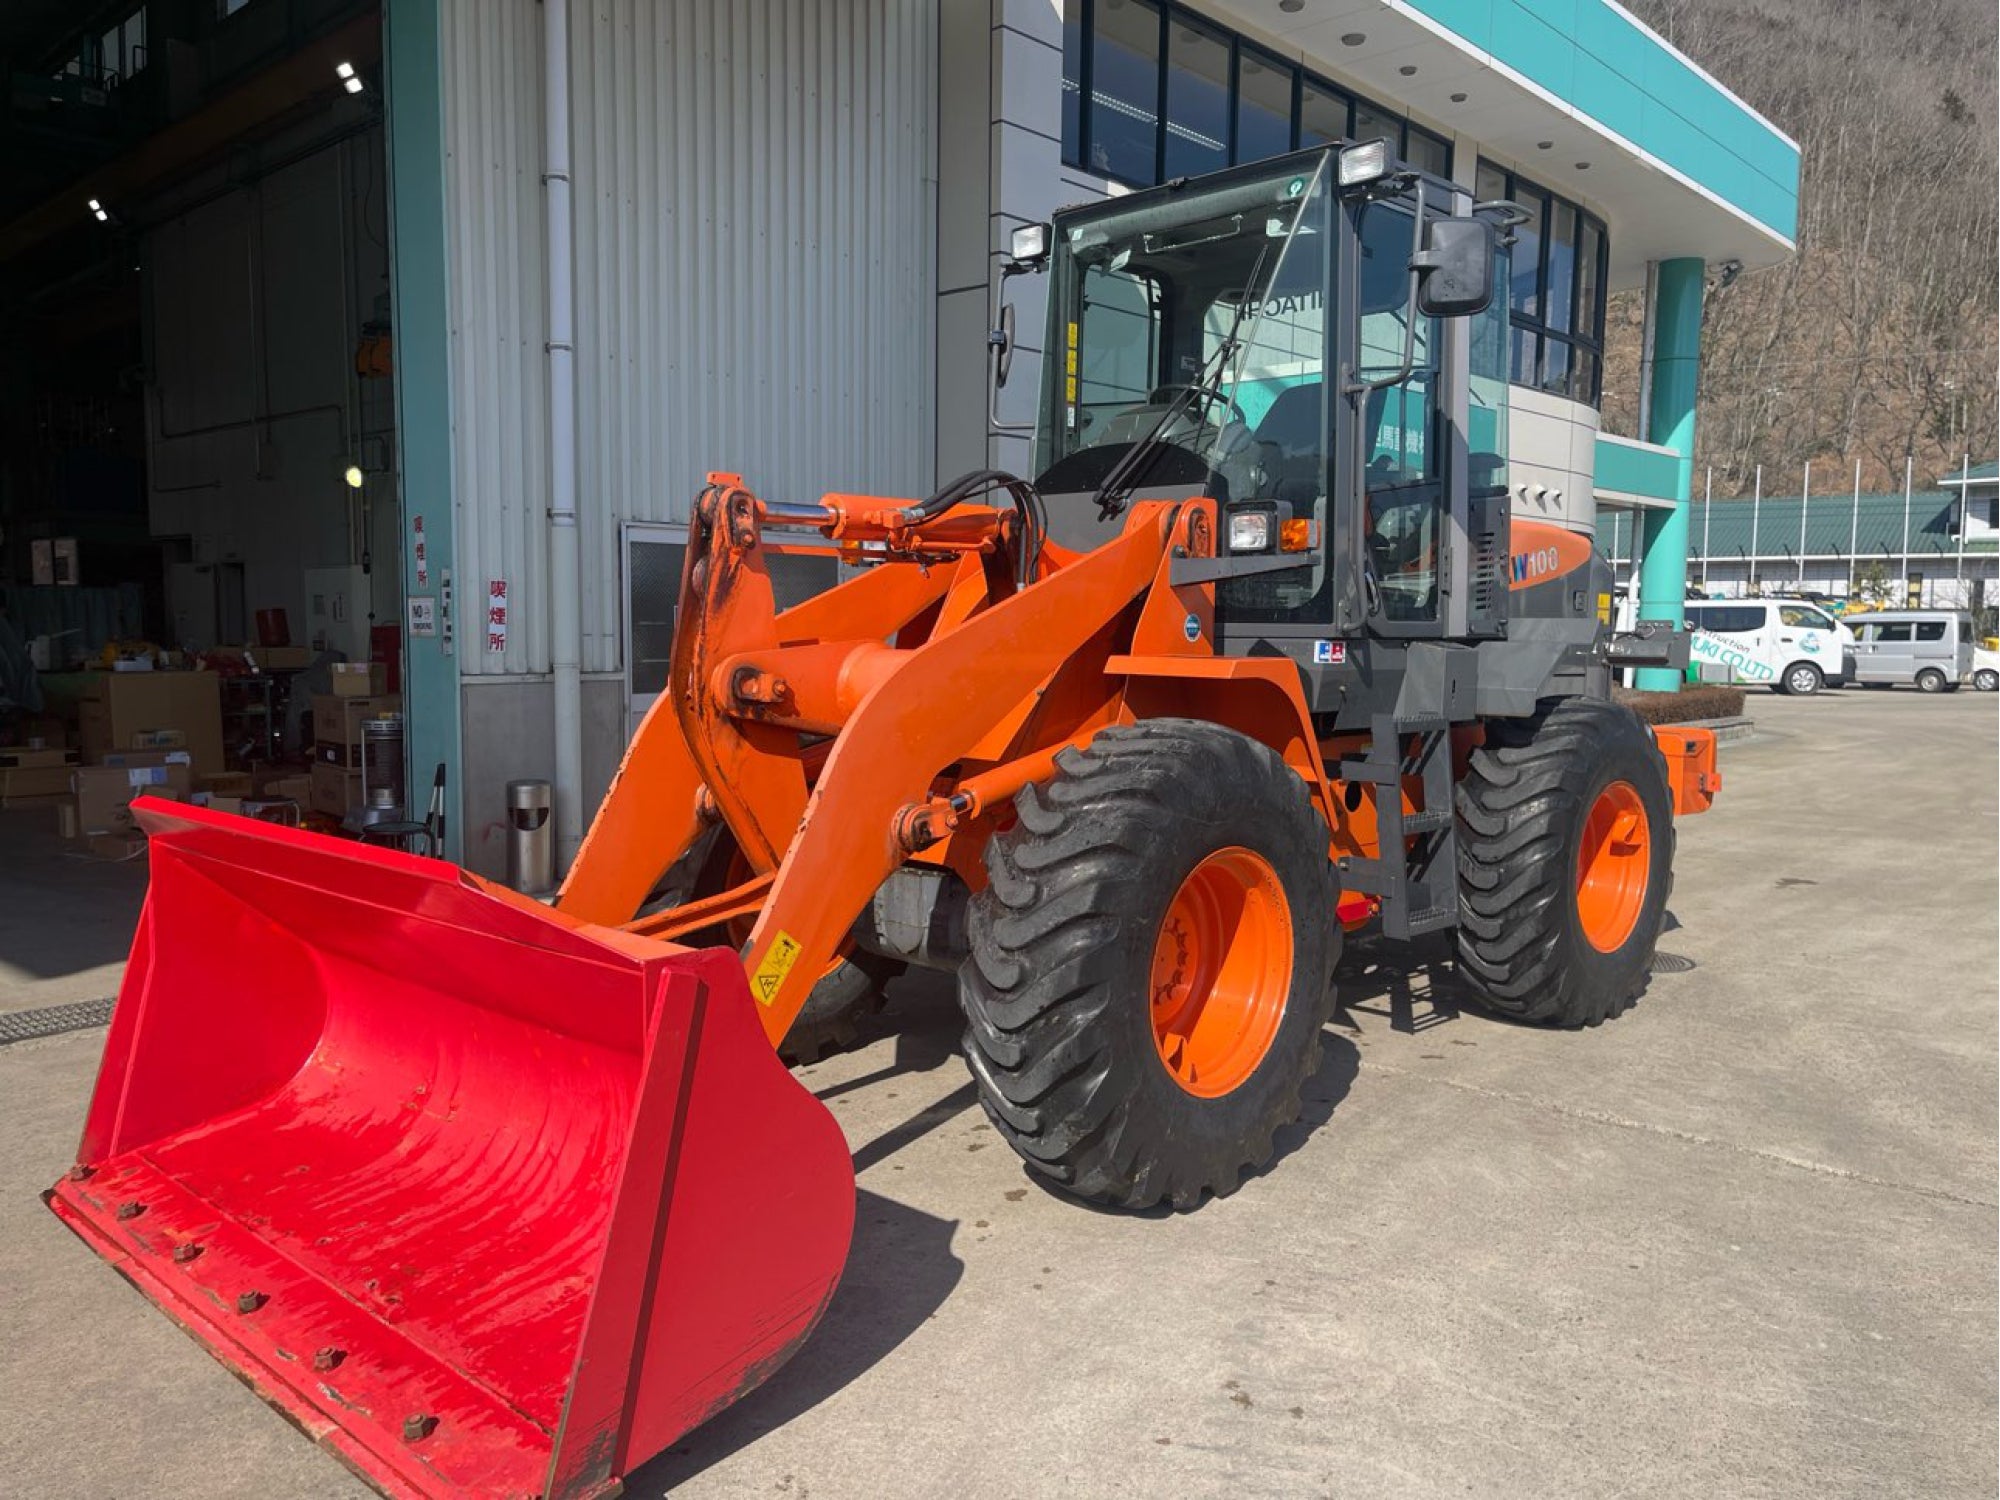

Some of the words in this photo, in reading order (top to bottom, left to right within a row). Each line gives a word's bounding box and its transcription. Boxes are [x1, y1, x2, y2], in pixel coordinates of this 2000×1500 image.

[1509, 546, 1559, 584] W100
[489, 580, 507, 652] 喫煙所
